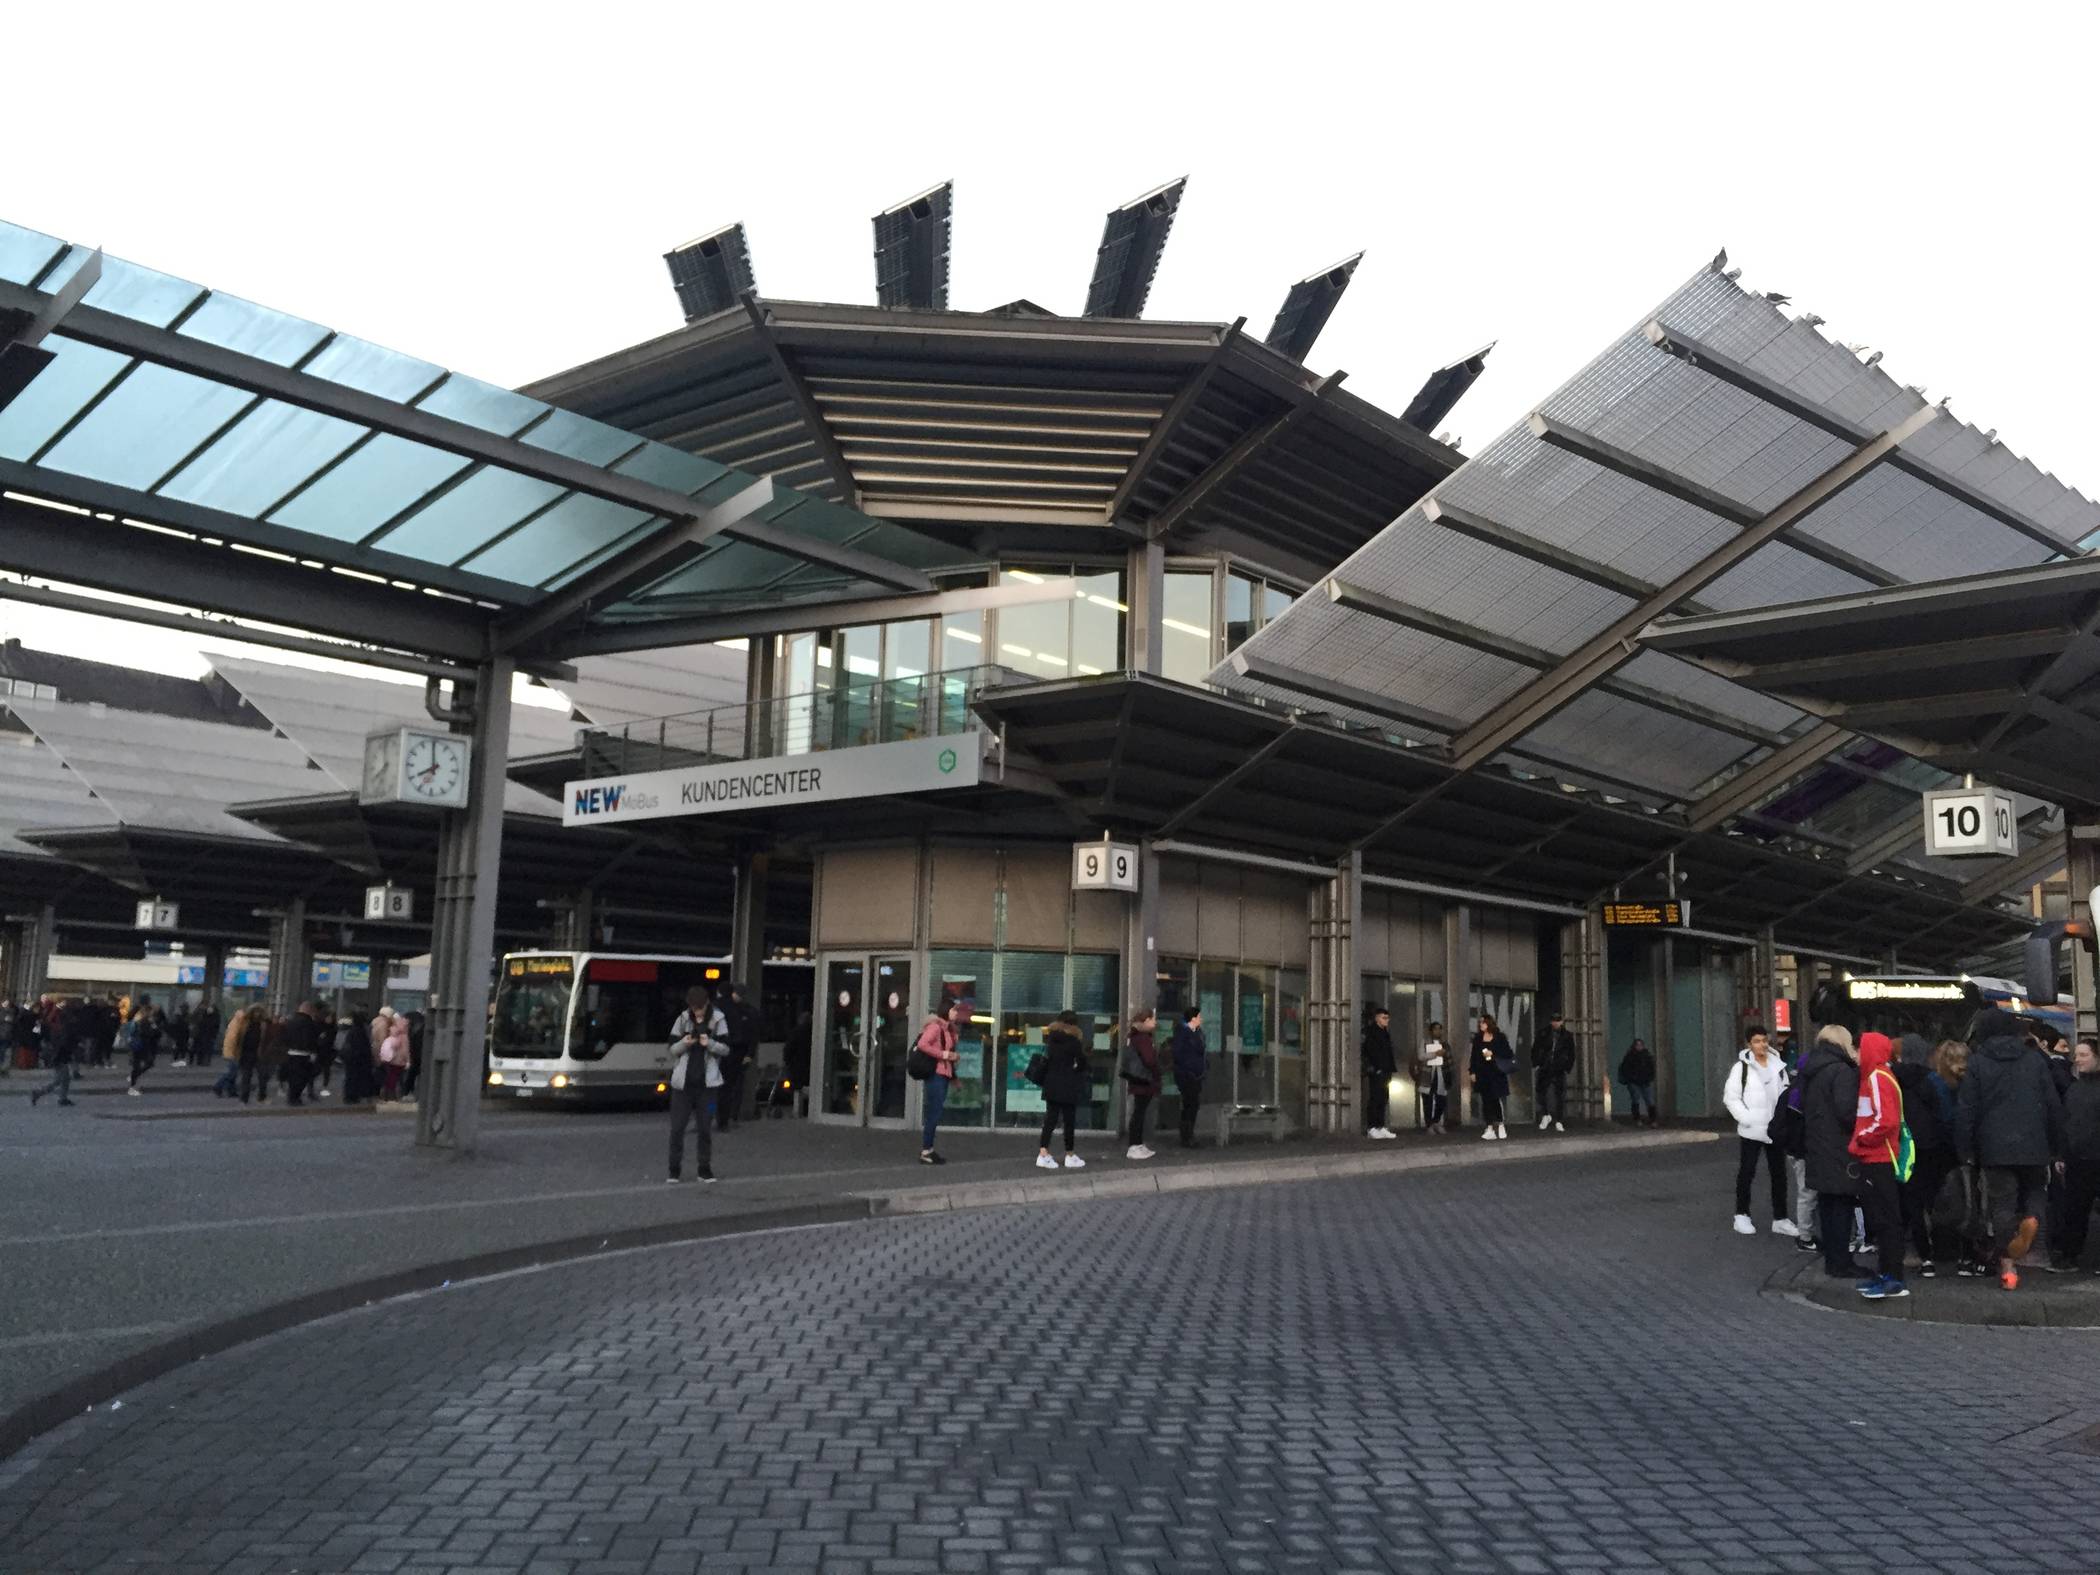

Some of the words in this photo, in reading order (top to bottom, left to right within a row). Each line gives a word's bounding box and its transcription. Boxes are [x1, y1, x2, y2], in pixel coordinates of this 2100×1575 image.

[681, 768, 822, 805] KUNDENCENTER
[1938, 805, 1981, 837] 10
[1995, 807, 2009, 839] 10
[1086, 854, 1098, 877] 9
[1116, 856, 1127, 879] 9
[160, 908, 169, 922] 7
[392, 895, 402, 912] 8
